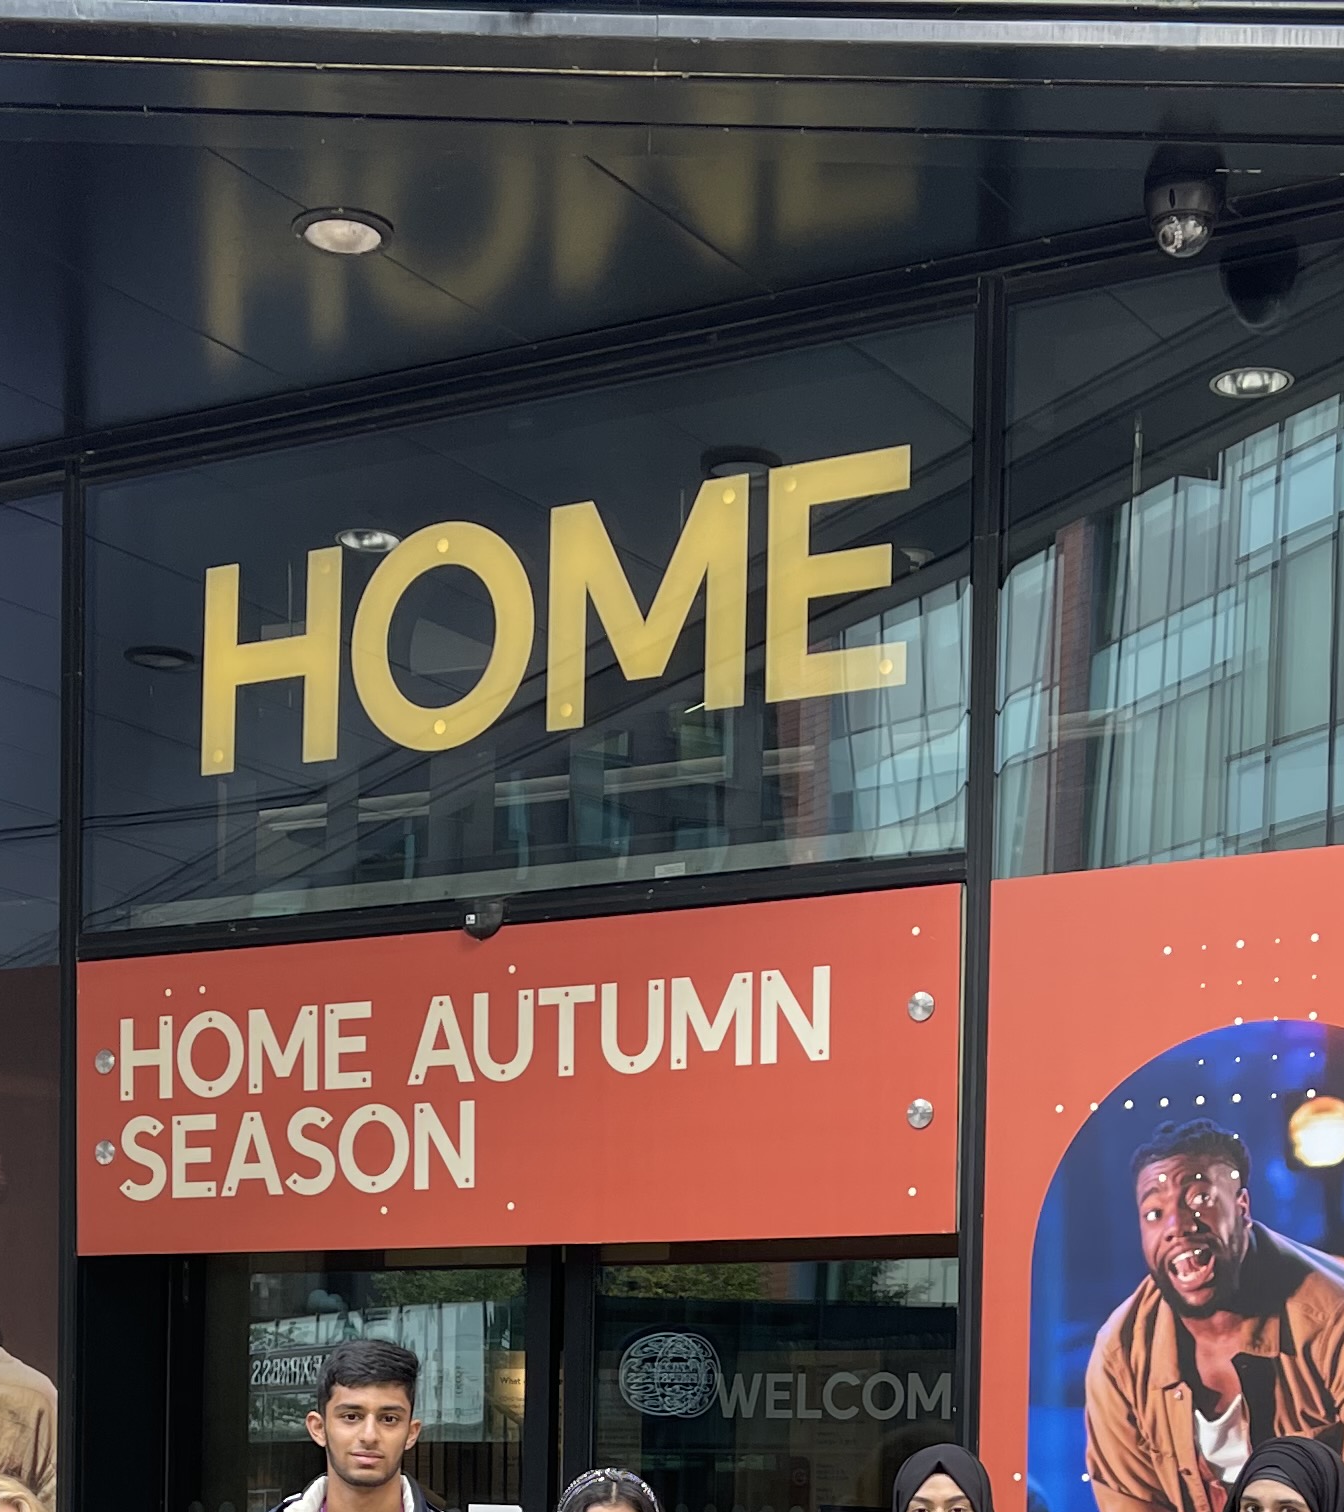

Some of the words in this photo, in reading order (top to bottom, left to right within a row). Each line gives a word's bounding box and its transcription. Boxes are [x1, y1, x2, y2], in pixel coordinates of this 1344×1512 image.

[201, 444, 911, 777] HOME
[118, 1001, 372, 1102] HOME
[407, 965, 831, 1086] AUTUMN
[120, 1100, 477, 1201] SEASON
[716, 1372, 952, 1420] WELCOM
